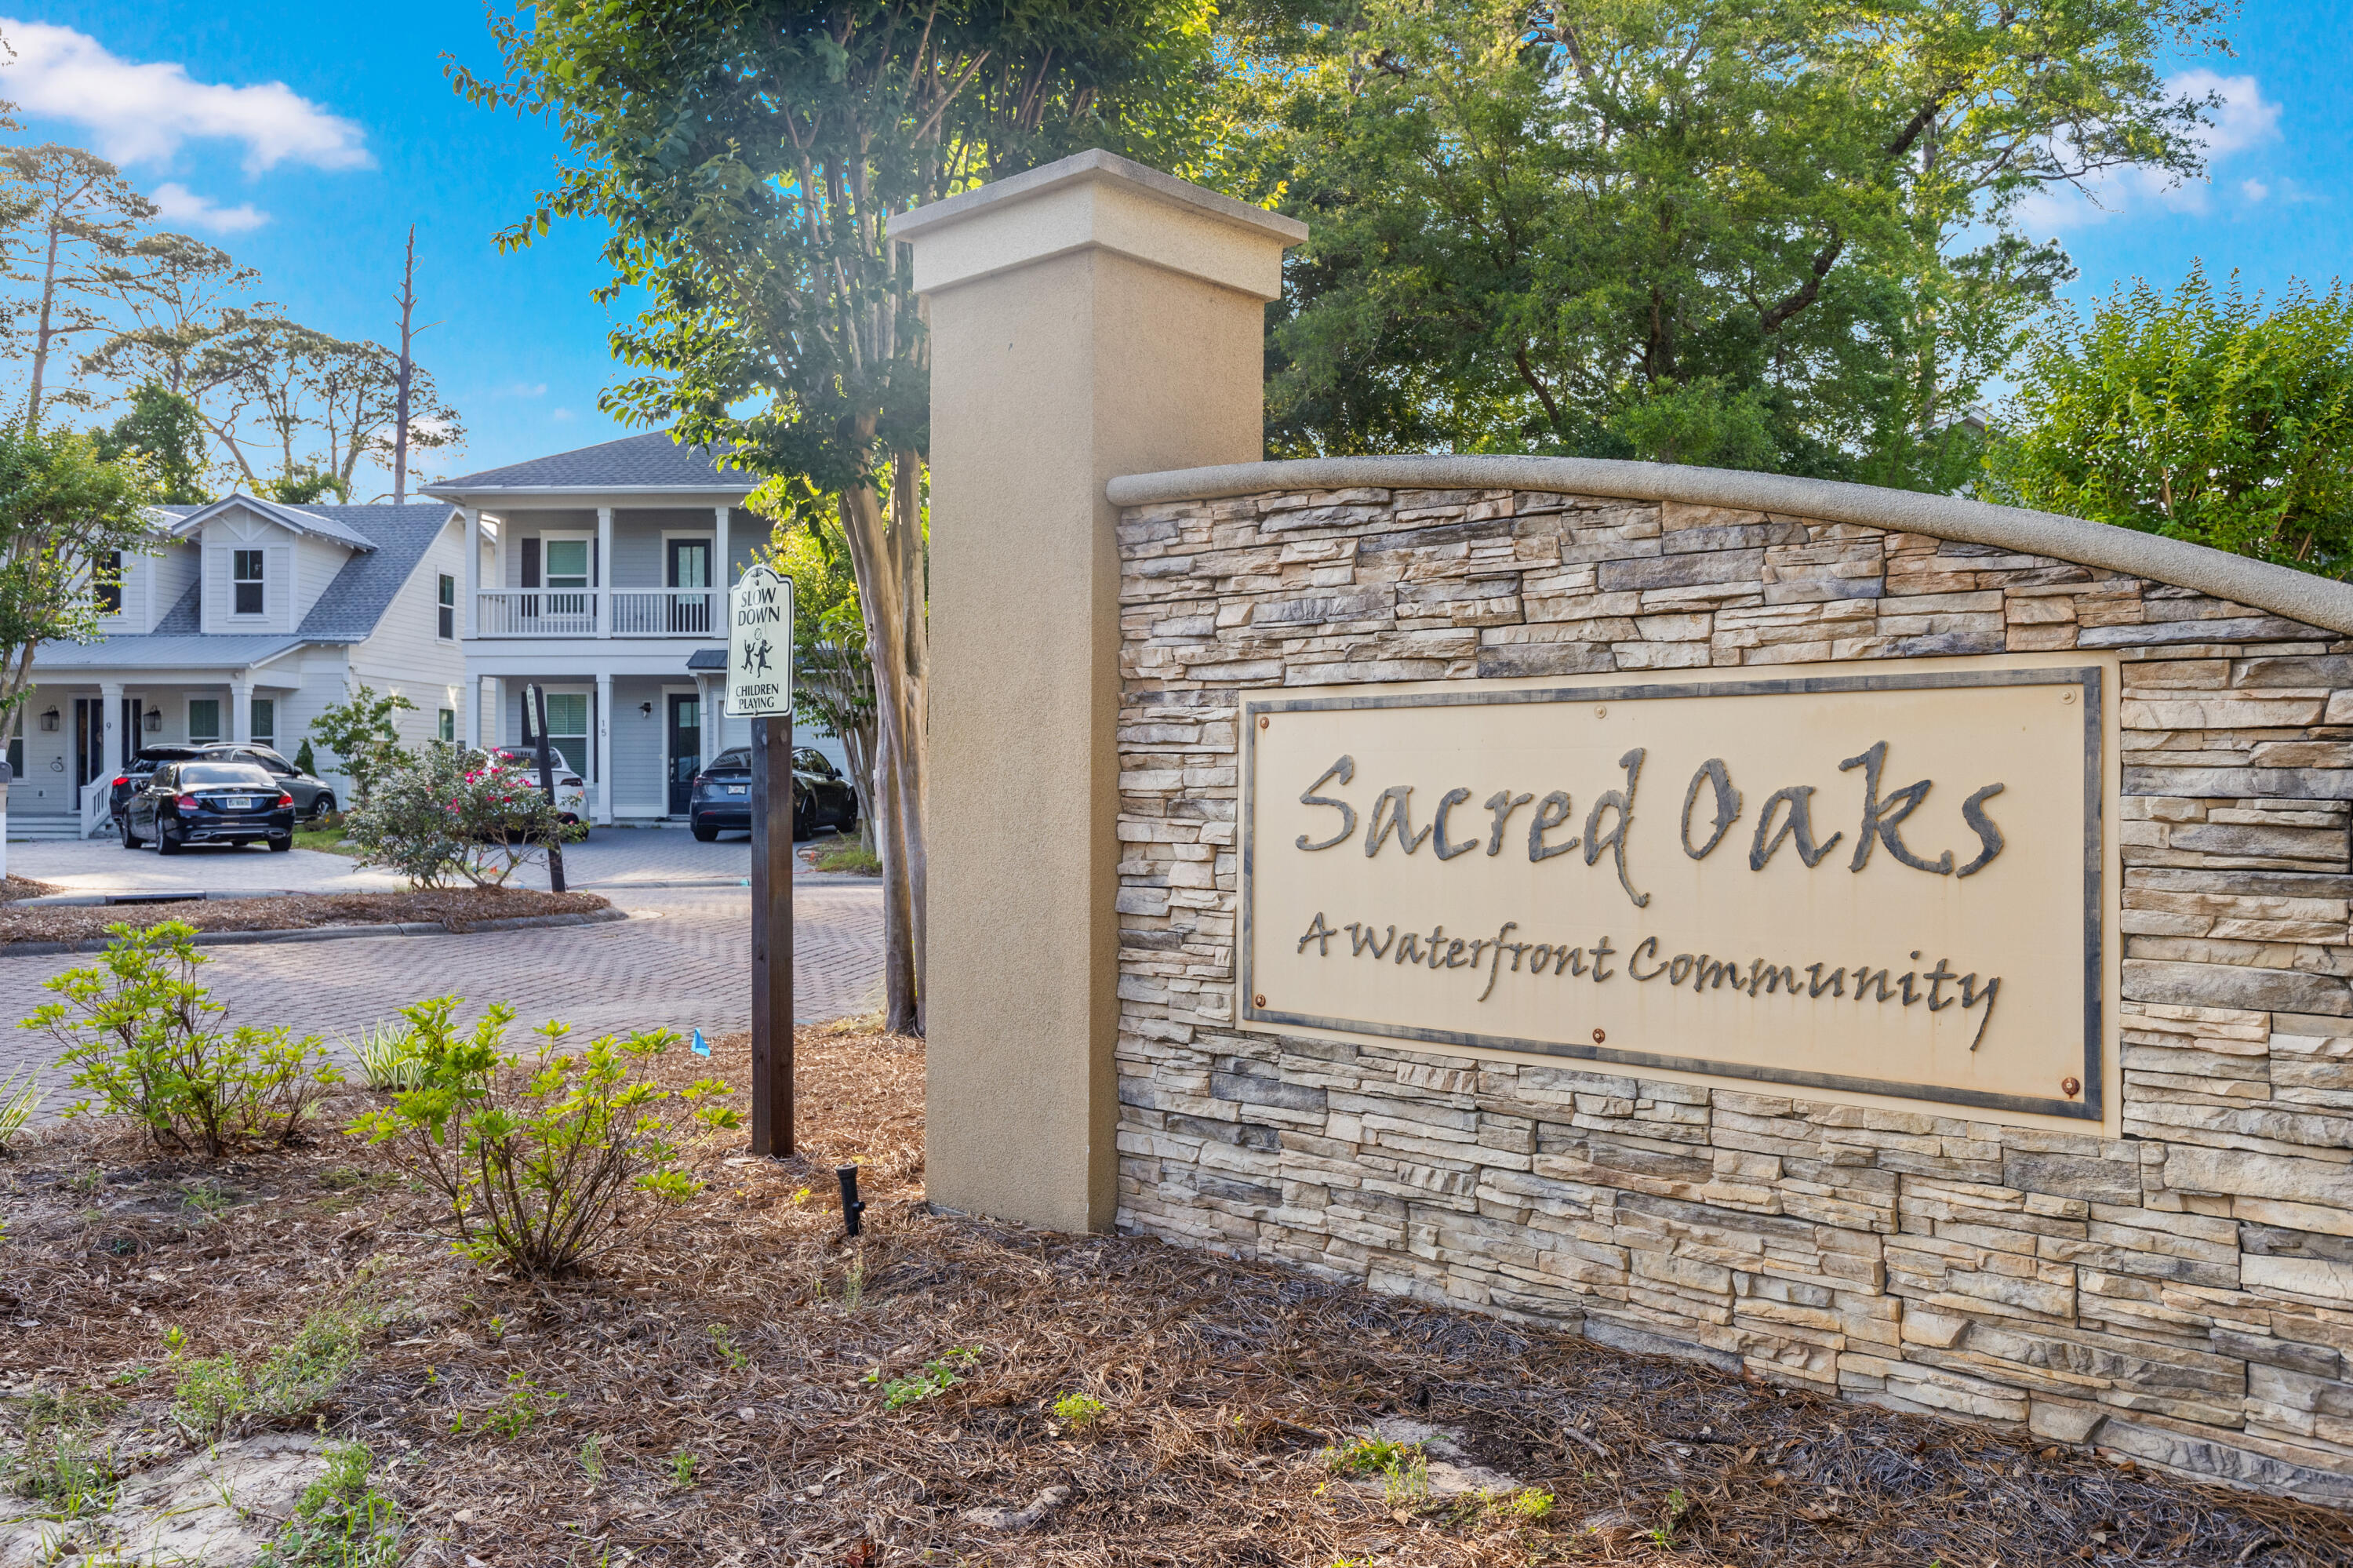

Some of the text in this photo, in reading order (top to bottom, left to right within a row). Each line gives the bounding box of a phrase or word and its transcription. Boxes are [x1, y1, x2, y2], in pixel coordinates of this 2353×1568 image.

[740, 588, 776, 608] SLOW
[738, 606, 780, 626] DOWN
[736, 683, 779, 697] CHILDREN
[739, 697, 775, 710] PLAYING
[1294, 740, 2006, 909] Sacred Oaks
[1297, 911, 2002, 1053] A Waterfront Community
